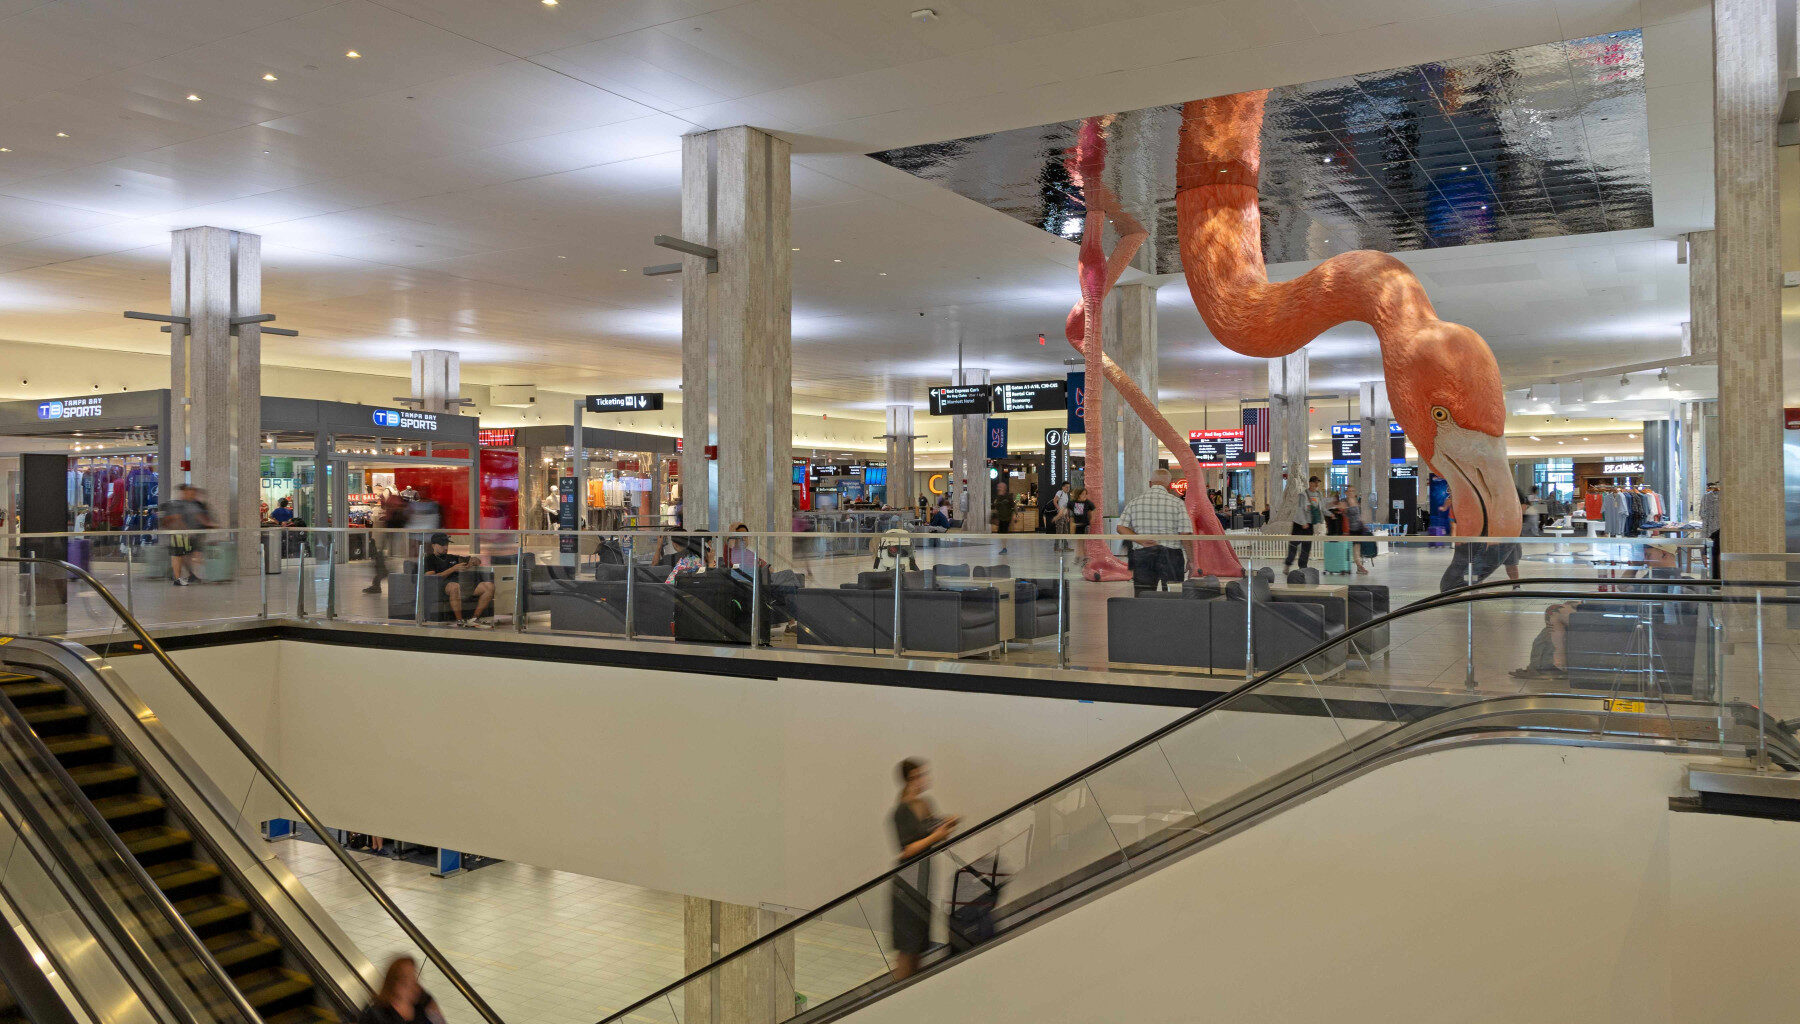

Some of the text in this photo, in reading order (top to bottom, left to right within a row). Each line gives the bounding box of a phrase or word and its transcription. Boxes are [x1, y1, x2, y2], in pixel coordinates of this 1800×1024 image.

[64, 399, 86, 407] TAMPA
[596, 397, 625, 406] Ticketing
[63, 405, 102, 418] SPORTS
[400, 411, 423, 419] TAMPA
[400, 418, 437, 430] SPORTS
[261, 478, 302, 489] ORTS
[928, 474, 943, 494] C
